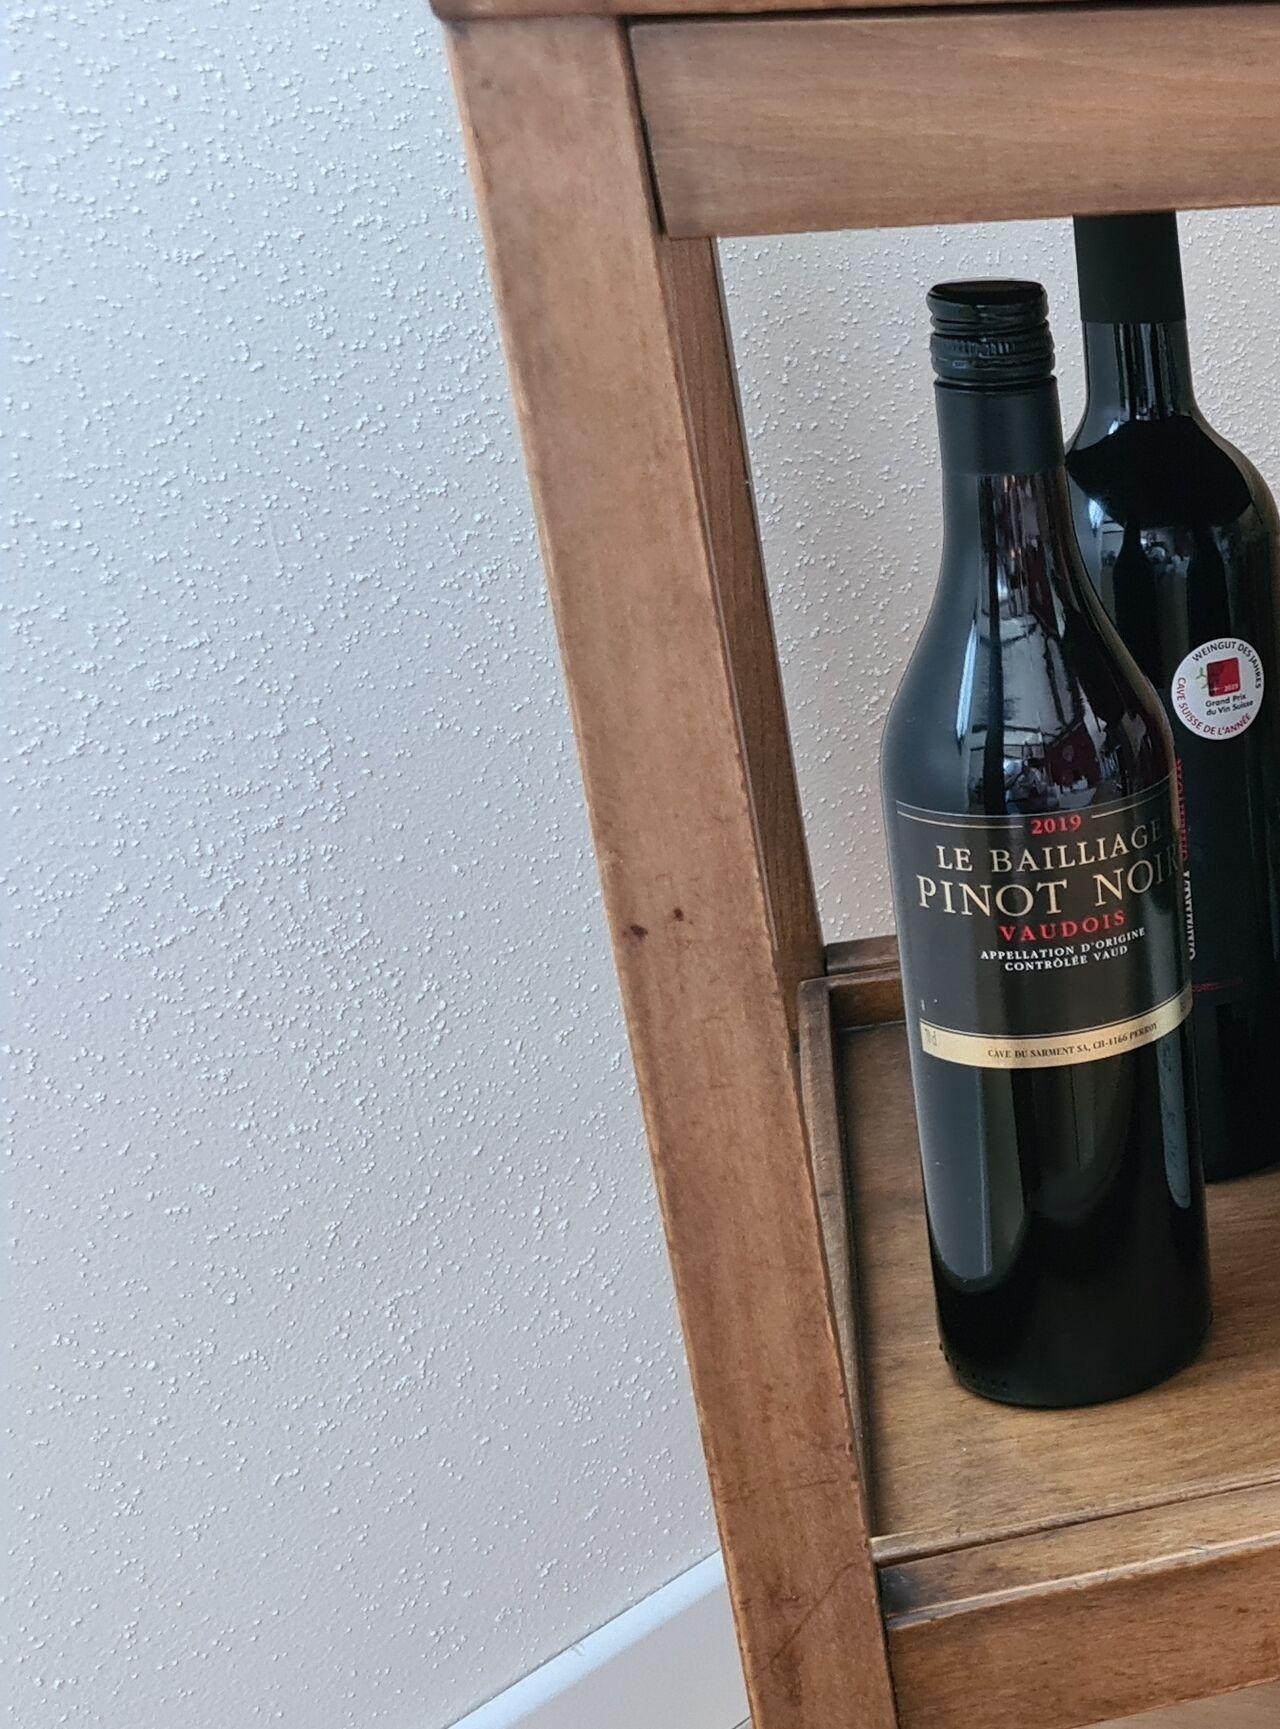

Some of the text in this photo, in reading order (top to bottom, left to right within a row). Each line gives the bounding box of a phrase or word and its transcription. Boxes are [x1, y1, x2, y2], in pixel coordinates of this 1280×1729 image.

[1192, 641, 1261, 689] WEINGUT DES JAHRES
[1176, 677, 1186, 701] CAVE
[1205, 694, 1246, 708] Grand Prix
[1179, 702, 1203, 729] SUISSE
[1218, 705, 1230, 713] Vin
[1232, 700, 1254, 711] Suisse
[1203, 725, 1216, 735] DE
[1031, 814, 1083, 835] 2019
[936, 819, 1161, 873] LE BAILLIAGE
[916, 843, 1179, 918] PINOT NOIR
[999, 909, 1128, 942] VAUDOIS
[980, 926, 1146, 961] APPELLATION D'ORIGINE
[1004, 945, 1129, 972] CONTRÔLÉE VAUD
[987, 1048, 1011, 1058] CAVE
[1014, 1048, 1028, 1058] DU
